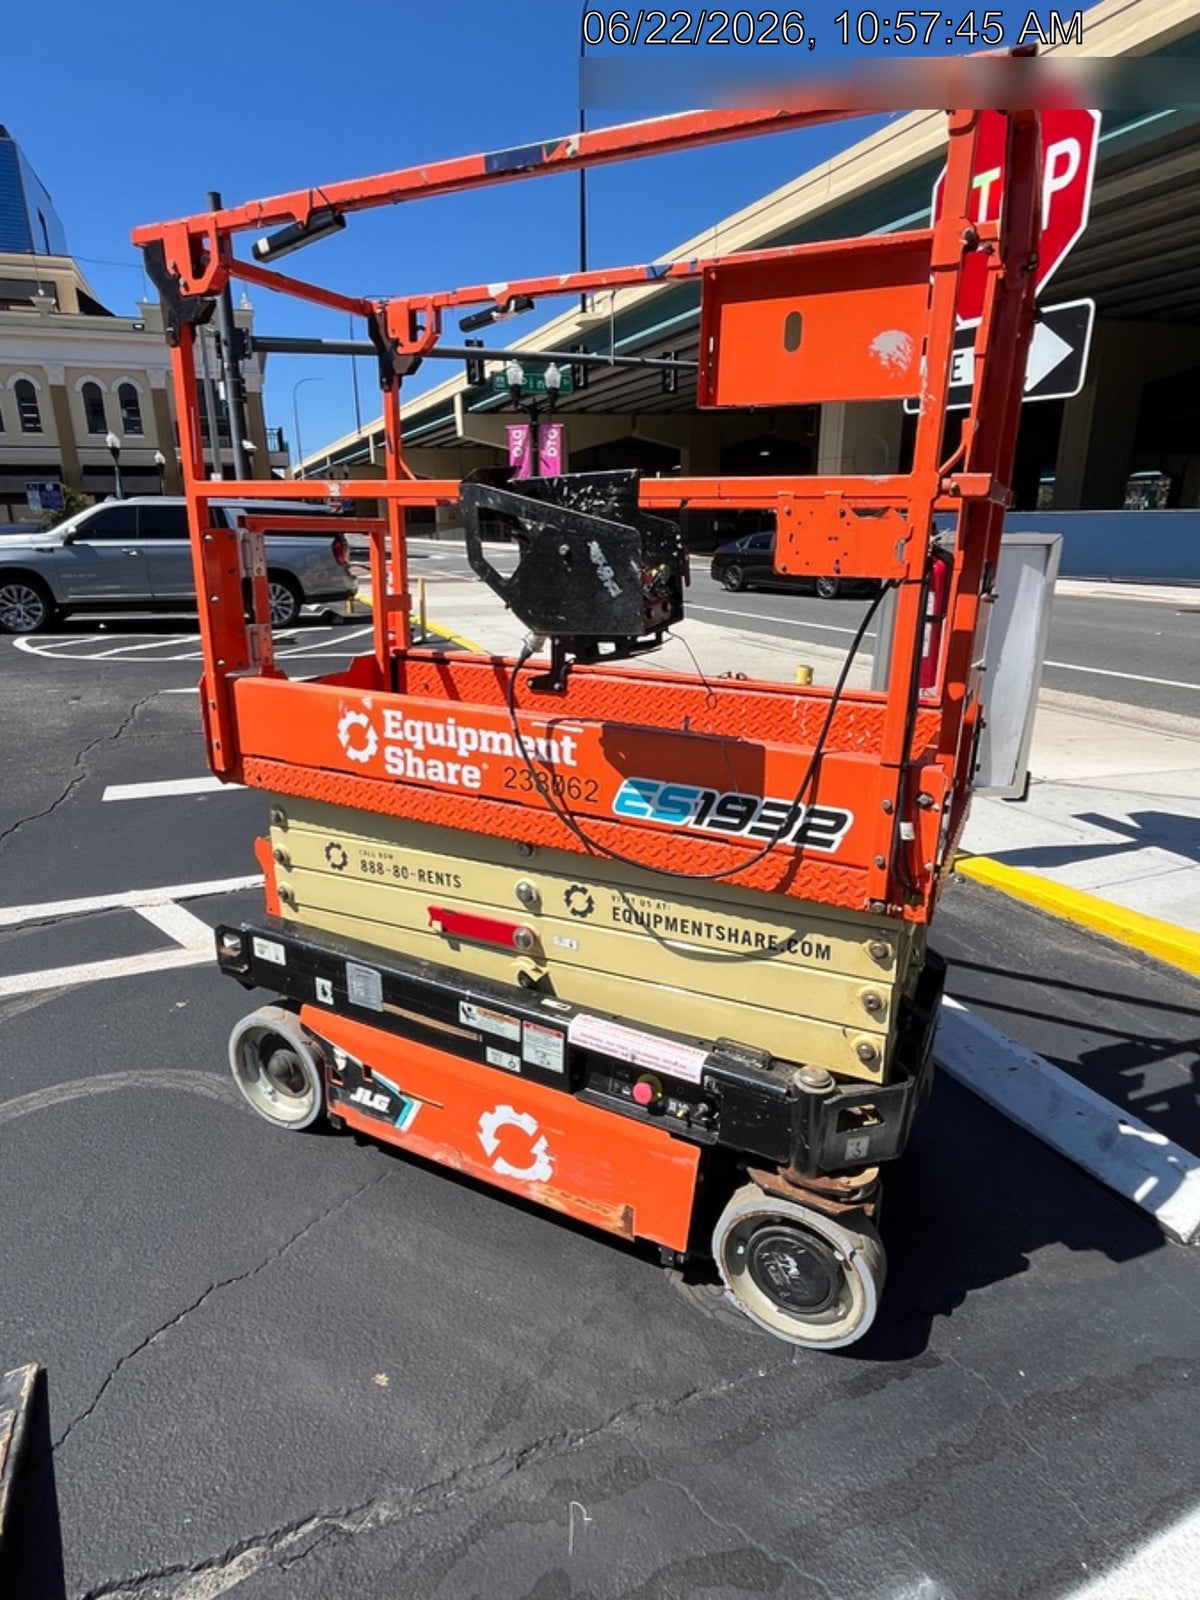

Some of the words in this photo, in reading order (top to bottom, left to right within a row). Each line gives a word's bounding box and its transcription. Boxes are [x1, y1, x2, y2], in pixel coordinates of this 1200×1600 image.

[382, 708, 578, 767] Equipment
[613, 777, 853, 853] ES1932
[360, 859, 462, 889] 888-80-RENTS
[612, 906, 831, 961] EQUIPMENTSHARE.COM
[350, 1087, 390, 1113] JLG
